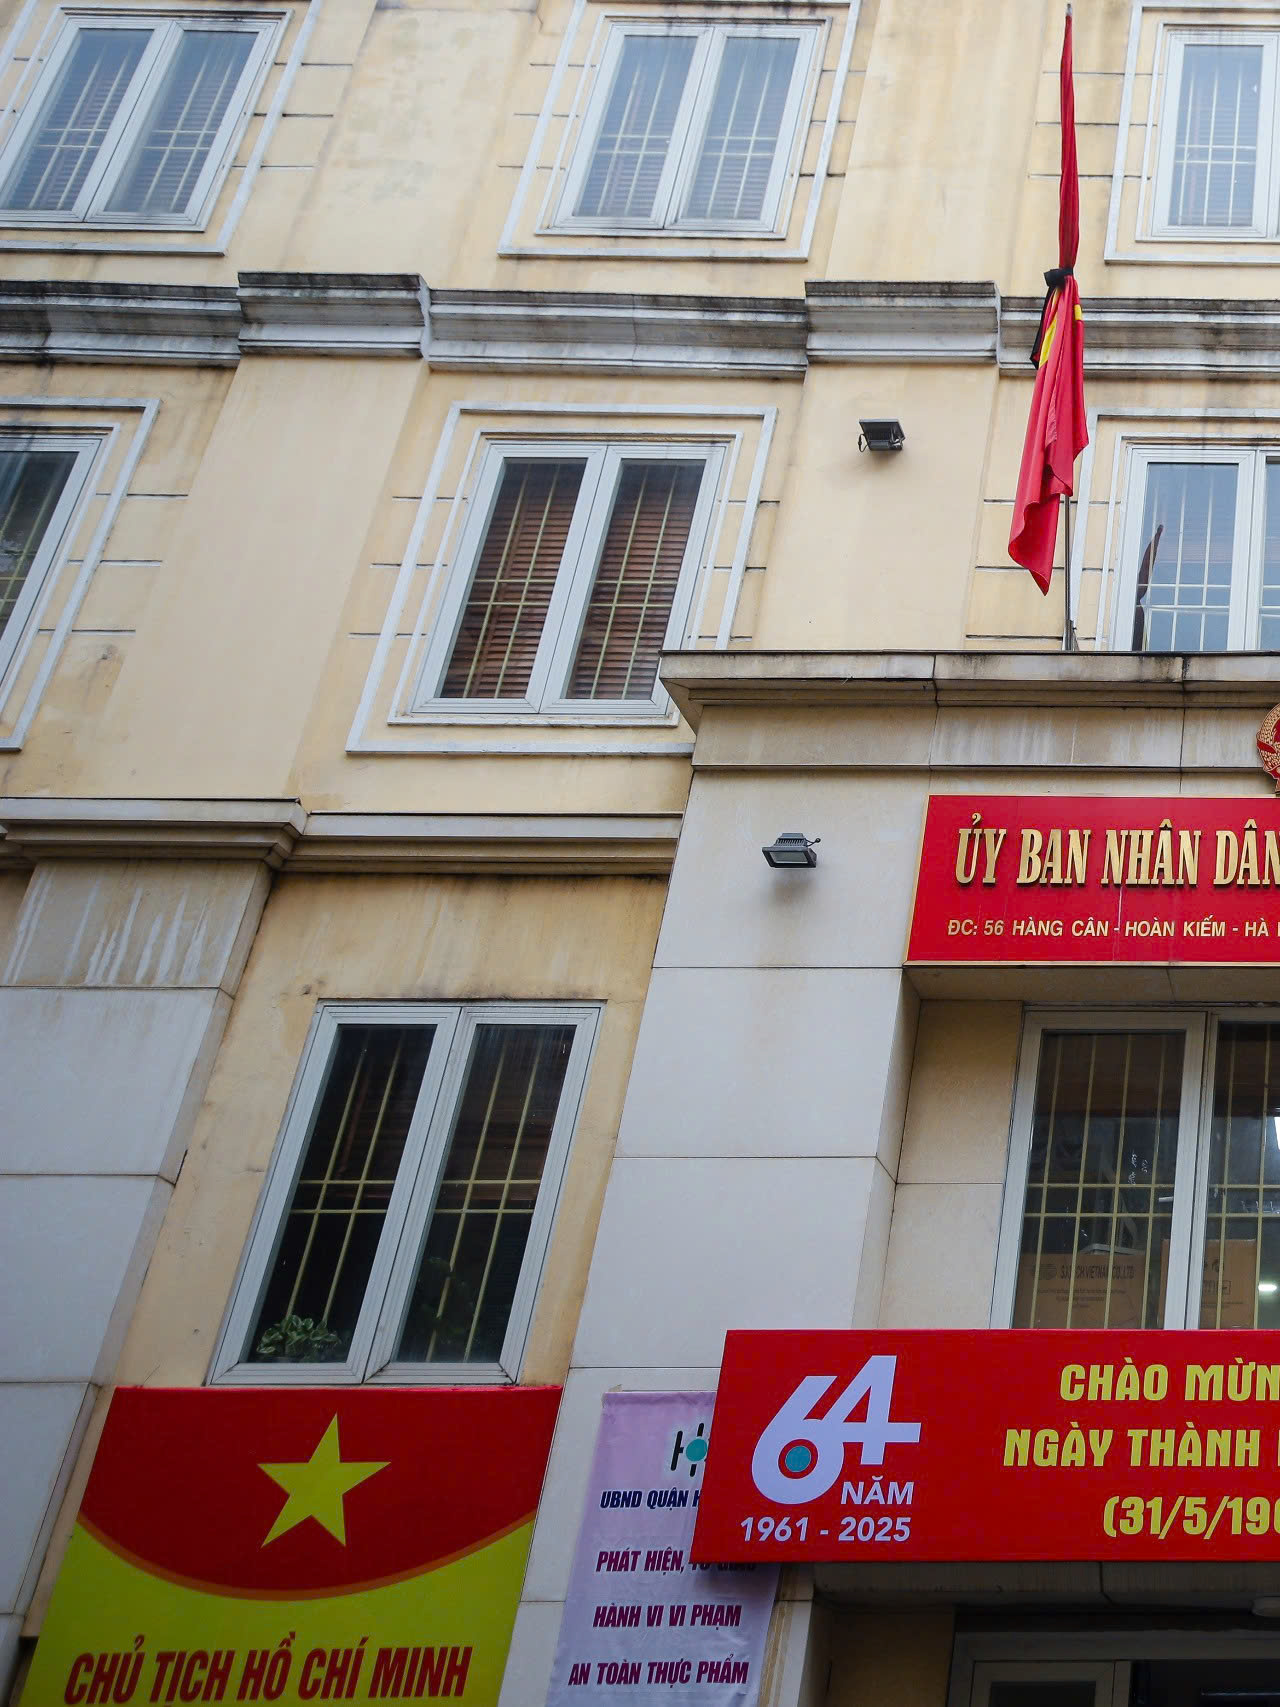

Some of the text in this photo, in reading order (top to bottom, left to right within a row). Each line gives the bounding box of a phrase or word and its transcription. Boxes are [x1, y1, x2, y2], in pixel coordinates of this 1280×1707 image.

[955, 812, 1007, 885] ỦY
[1015, 828, 1092, 885] BAN
[1100, 818, 1202, 886] NHÂN
[947, 919, 978, 937] ĐC:
[983, 919, 1005, 937] 56
[1012, 916, 1063, 937] HÀNG
[1071, 916, 1109, 937] CÂN
[1124, 917, 1176, 937] HOÀN
[1183, 914, 1226, 937] KIẾM
[1244, 917, 1269, 937] HÀ
[1059, 1356, 1168, 1402] CHÀO
[751, 1355, 921, 1505] 64
[1002, 1421, 1113, 1467] NGÀY
[1127, 1421, 1260, 1467] THÀNH
[600, 1490, 643, 1509] UBND
[646, 1486, 689, 1511] QUẬN
[841, 1475, 914, 1505] NĂM
[740, 1516, 809, 1542] 1961
[838, 1516, 911, 1542] 2025
[595, 1546, 685, 1576] PHÁT HIỆN,
[592, 1602, 742, 1631] HÀNH VI VI PHẠM
[63, 1631, 474, 1707] CHỦ TỊCH HỒ CHÍ MINH
[567, 1653, 750, 1689] AN TOÀN THỰC PHẨM
